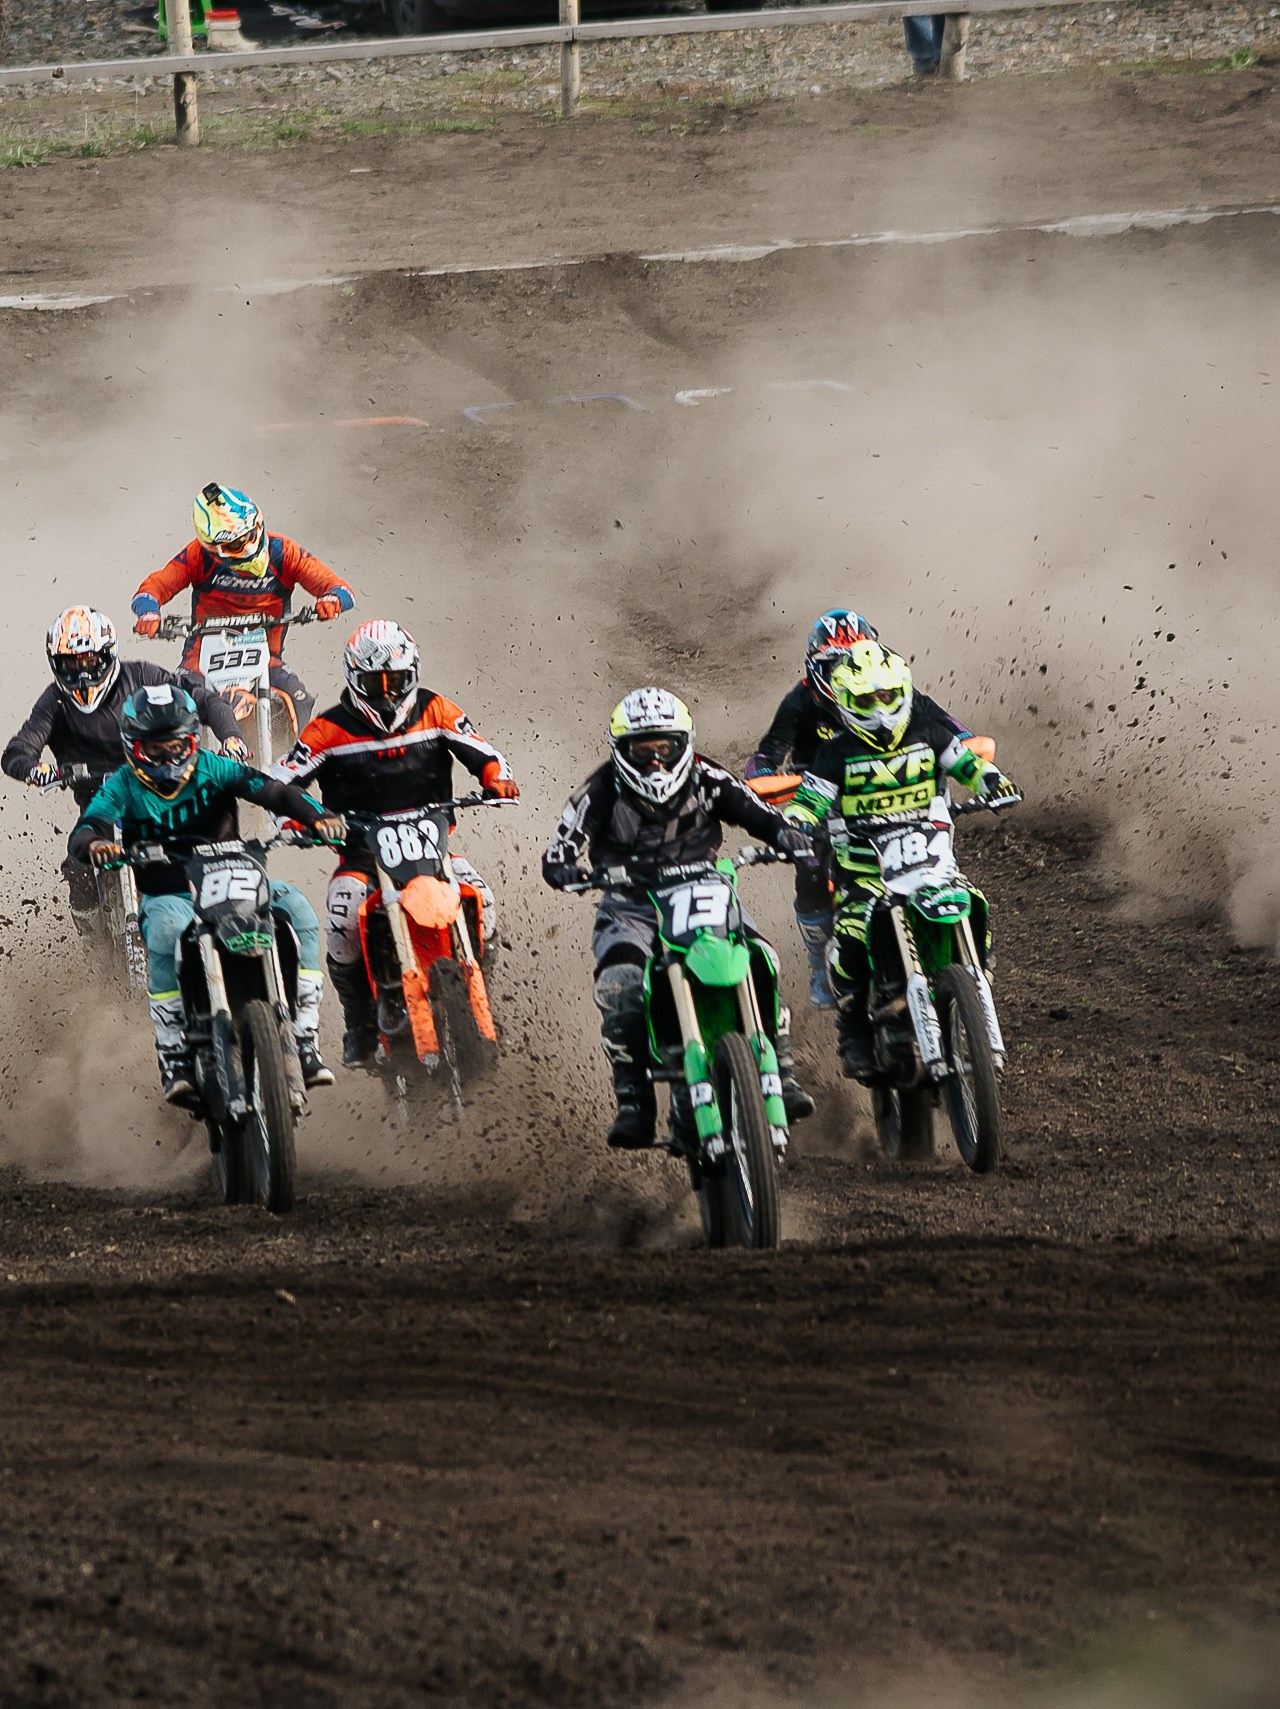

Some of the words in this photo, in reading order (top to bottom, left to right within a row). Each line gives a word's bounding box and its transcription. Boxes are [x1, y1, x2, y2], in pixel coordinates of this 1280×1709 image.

[211, 574, 274, 591] KENNY
[207, 649, 261, 673] 533
[855, 787, 929, 816] MOTO
[376, 818, 440, 869] 882
[200, 868, 262, 910] 82
[331, 890, 352, 938] FOX
[670, 884, 730, 937] 13
